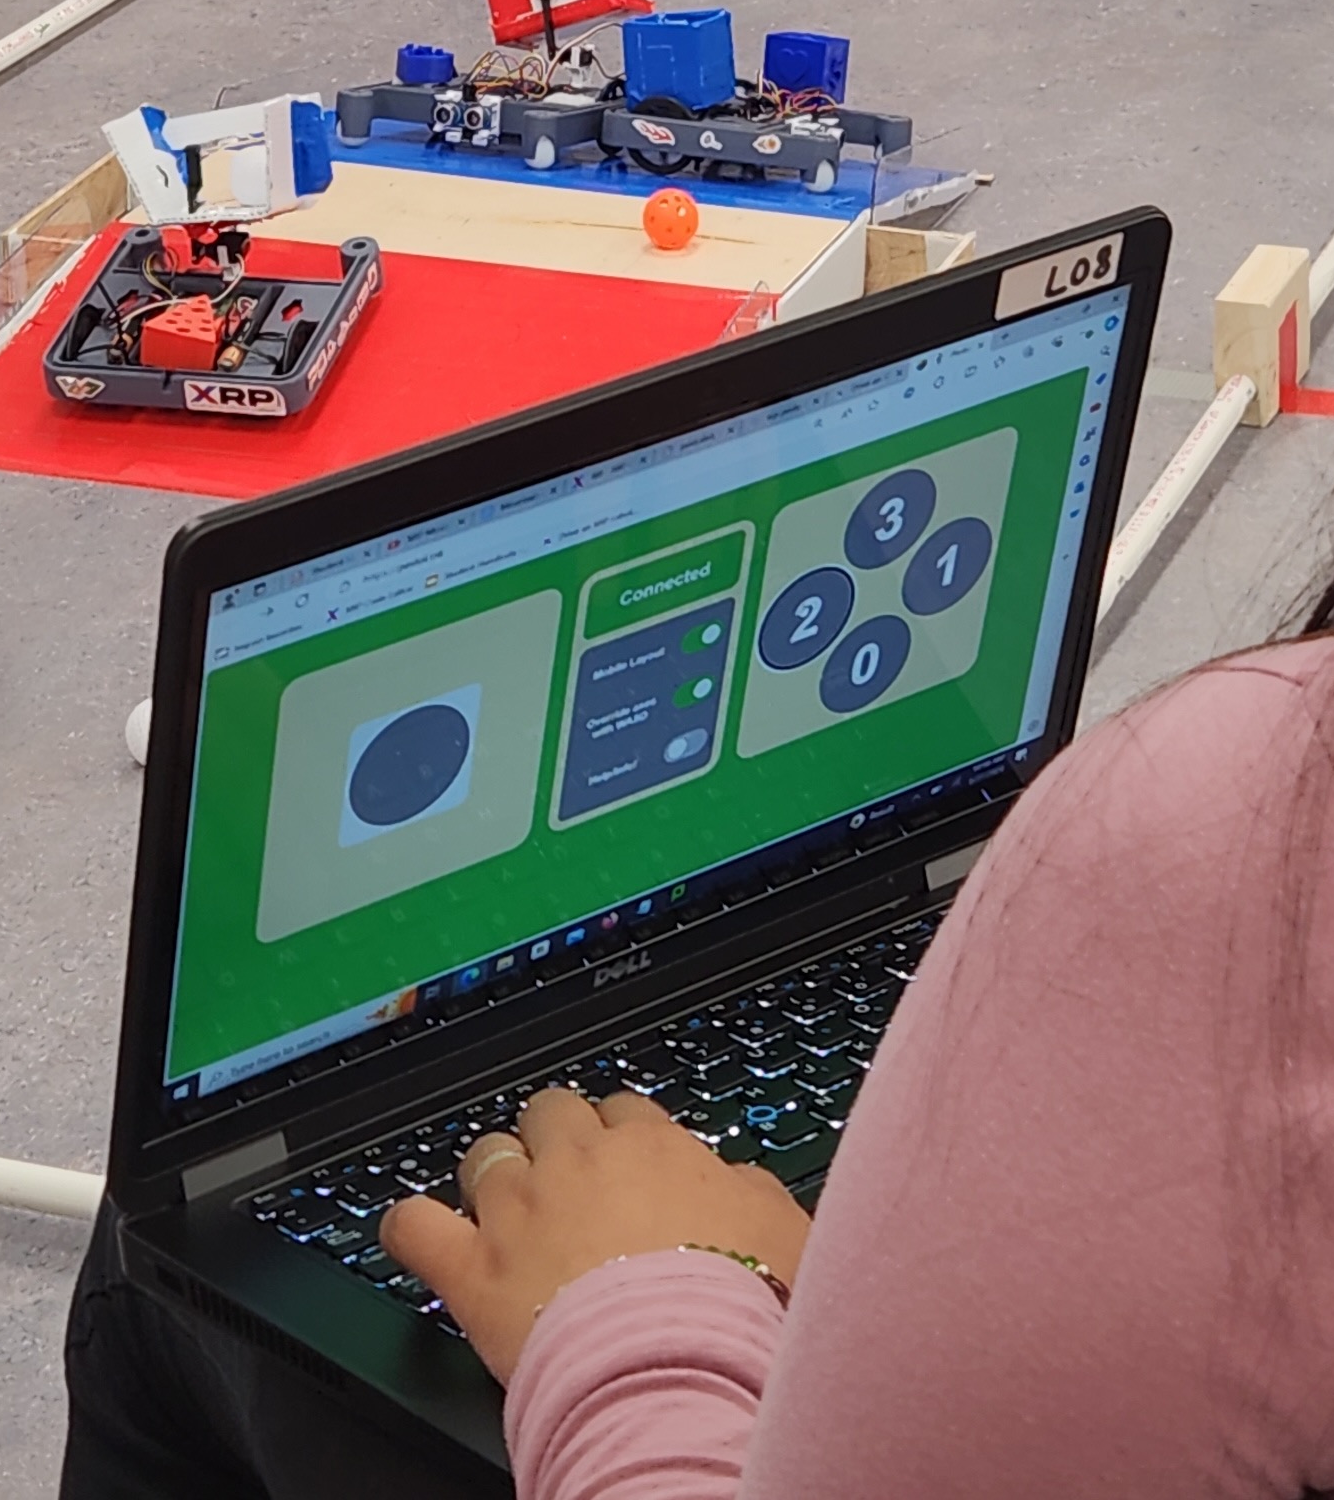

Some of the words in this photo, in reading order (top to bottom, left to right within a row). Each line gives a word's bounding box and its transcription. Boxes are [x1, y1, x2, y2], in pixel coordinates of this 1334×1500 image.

[188, 383, 275, 407] XRP
[874, 497, 905, 542] 3
[619, 561, 712, 606] Connected
[936, 544, 958, 586] 1
[789, 596, 823, 644] 2
[629, 647, 666, 670] Layout
[851, 642, 880, 685] 0
[593, 950, 652, 988] DELL
[230, 1059, 256, 1080] Type
[257, 1049, 282, 1068] here
[297, 1031, 332, 1053] search
